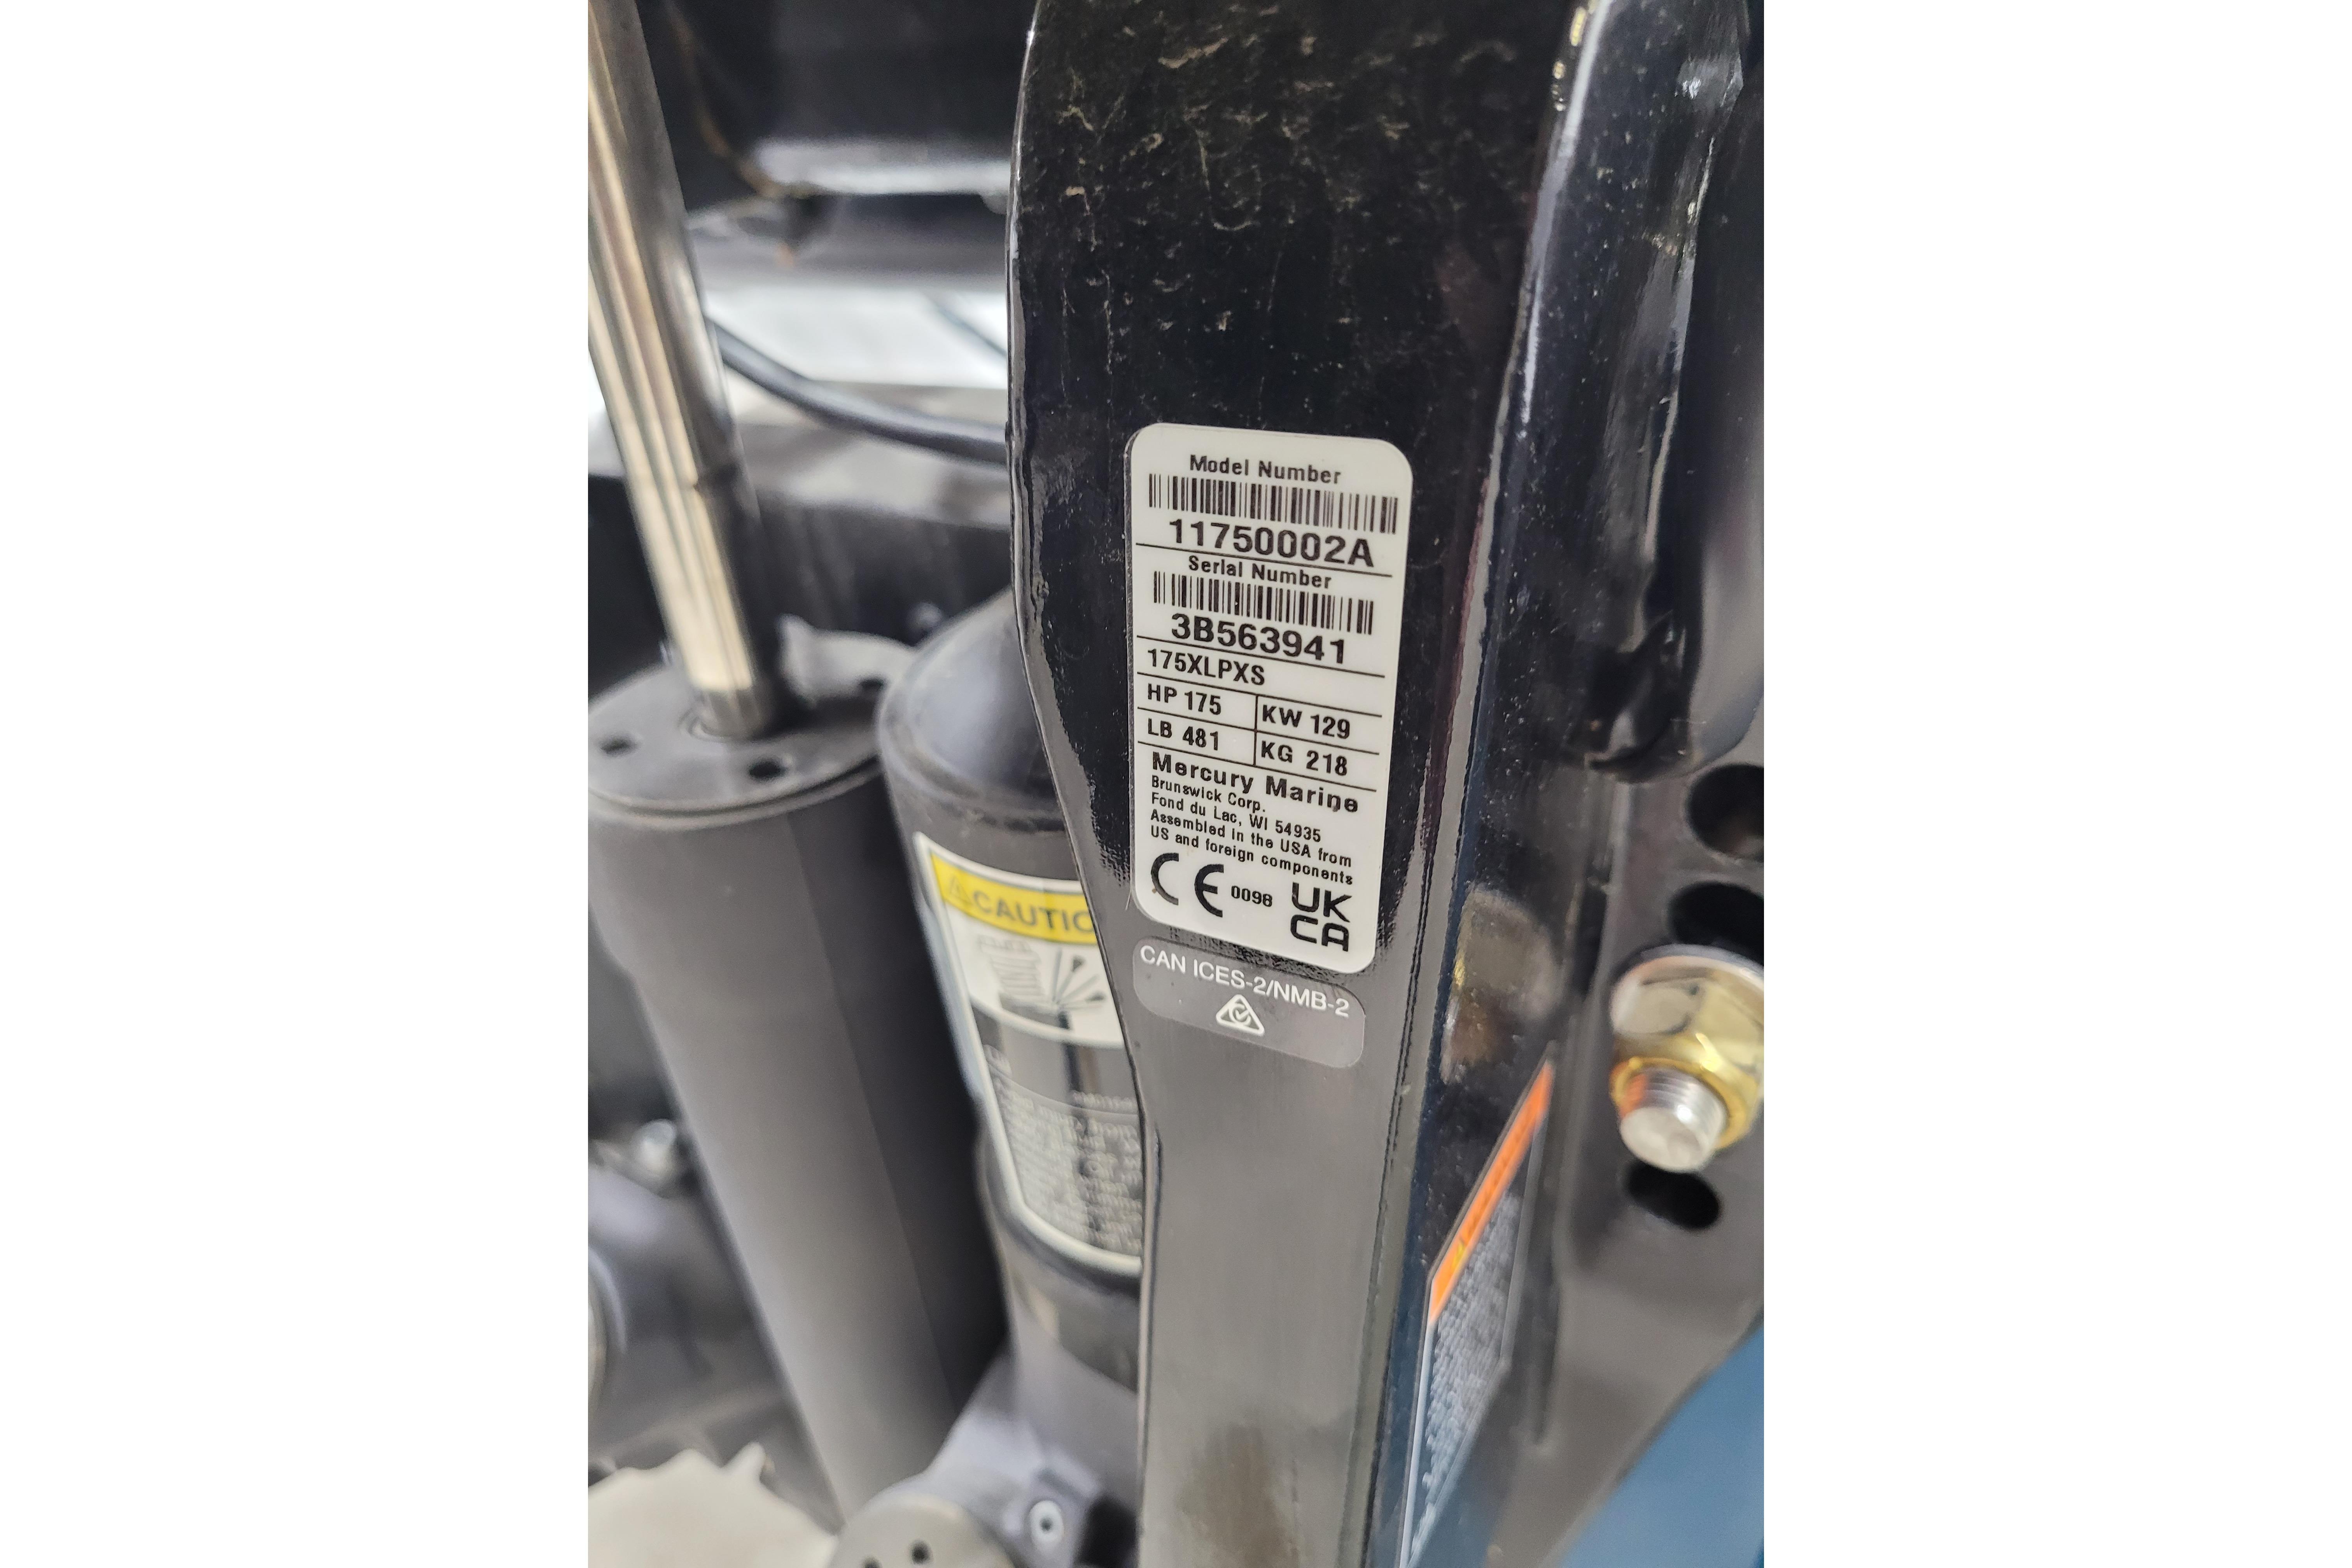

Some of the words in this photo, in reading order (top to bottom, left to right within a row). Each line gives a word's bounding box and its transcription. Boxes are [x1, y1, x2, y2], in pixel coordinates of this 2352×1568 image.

[1190, 455, 1248, 476] Model
[1259, 460, 1340, 483] Number
[1169, 519, 1374, 567] 11750002A
[1189, 555, 1242, 577] Serial
[1252, 564, 1331, 588] Number
[1172, 613, 1344, 664] 3B563941
[1148, 649, 1264, 685] 175XLPXS
[1148, 684, 1177, 703] HP
[1185, 691, 1221, 715] 175
[1148, 718, 1172, 738] LB
[1183, 726, 1218, 751] 481
[1263, 705, 1302, 727] KW
[1311, 714, 1350, 739] 129
[1262, 740, 1292, 763] KG
[1306, 750, 1347, 776] 218
[1152, 776, 1222, 803] Brunswick
[1228, 793, 1265, 813] Corp.
[1153, 752, 1253, 793] Mercury
[1266, 775, 1358, 812] Marine
[1152, 792, 1183, 811] Fond
[1190, 802, 1205, 816] du
[1214, 806, 1241, 826] Lac,
[1250, 814, 1267, 830] WI
[1276, 820, 1321, 842] 54935
[1151, 810, 1225, 838] Assembled
[1232, 828, 1243, 842] in
[1251, 833, 1273, 848] the
[1281, 839, 1311, 858] USA
[1318, 848, 1351, 867] from
[1152, 825, 1168, 840] US
[1176, 834, 1199, 848] and
[1206, 838, 1253, 862] foreign
[1262, 855, 1353, 885] components
[972, 890, 1094, 933] CAUTIO
[1231, 886, 1272, 907] 0098
[1292, 882, 1352, 922] UK
[1290, 915, 1349, 952] CA
[1141, 946, 1185, 973] CAN
[1194, 959, 1349, 1017] ICES-2/NMB-2
